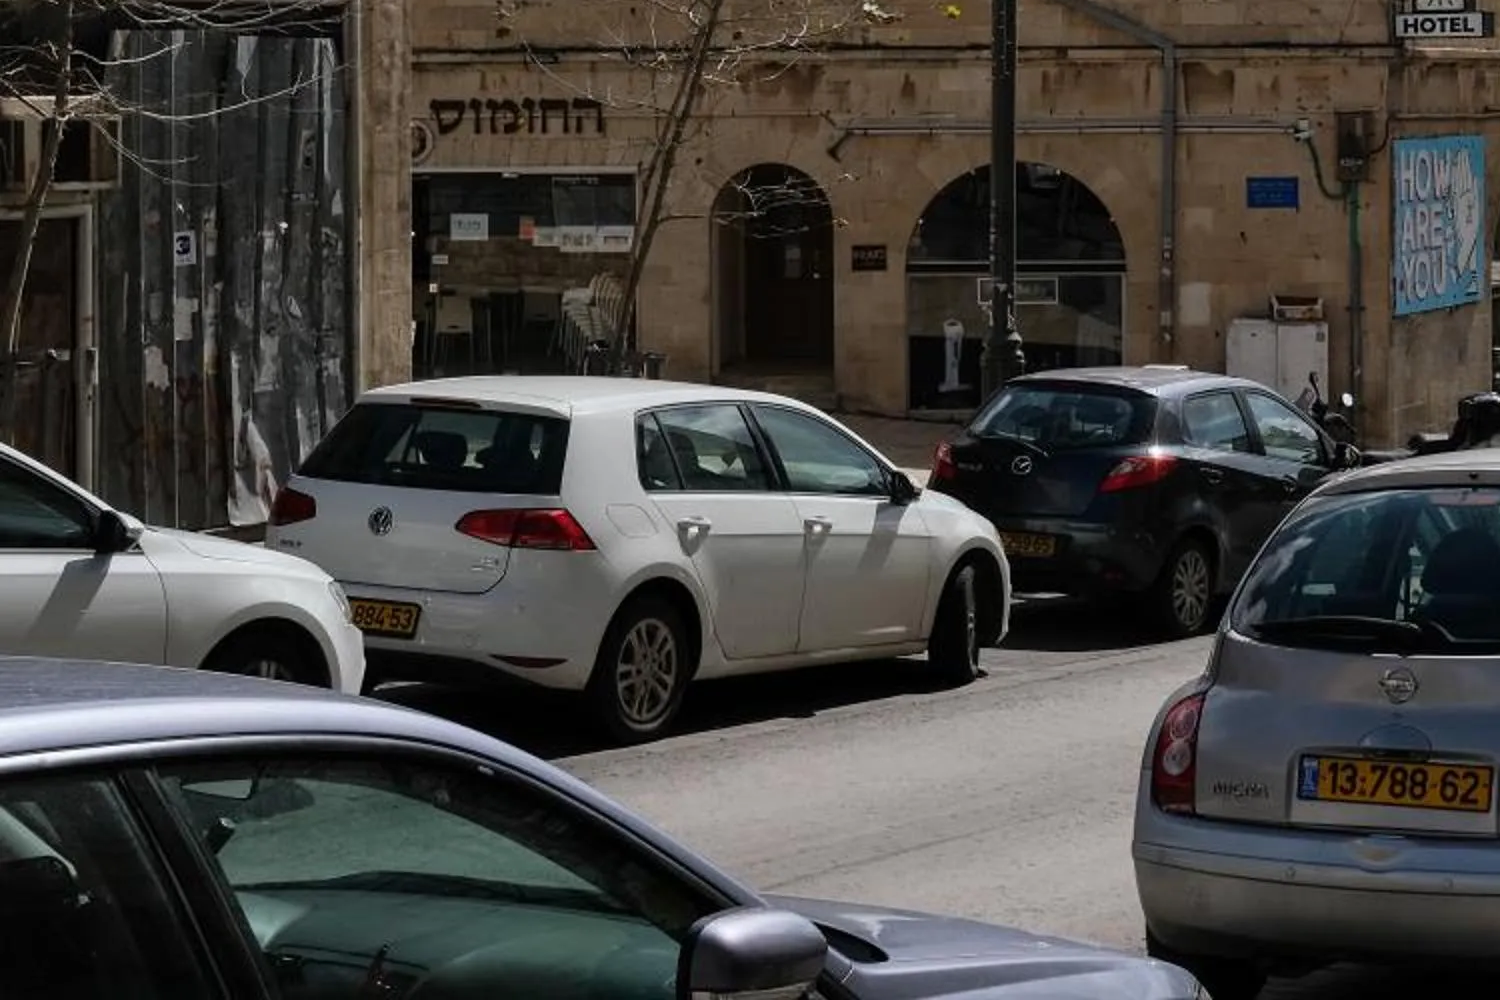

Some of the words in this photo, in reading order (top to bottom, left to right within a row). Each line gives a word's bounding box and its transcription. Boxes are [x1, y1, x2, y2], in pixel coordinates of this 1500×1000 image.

[1402, 16, 1475, 34] HOTEL
[429, 96, 604, 135] החומוס
[1400, 148, 1451, 203] HOW
[1402, 204, 1444, 252] ARE
[1403, 251, 1447, 304] YOU
